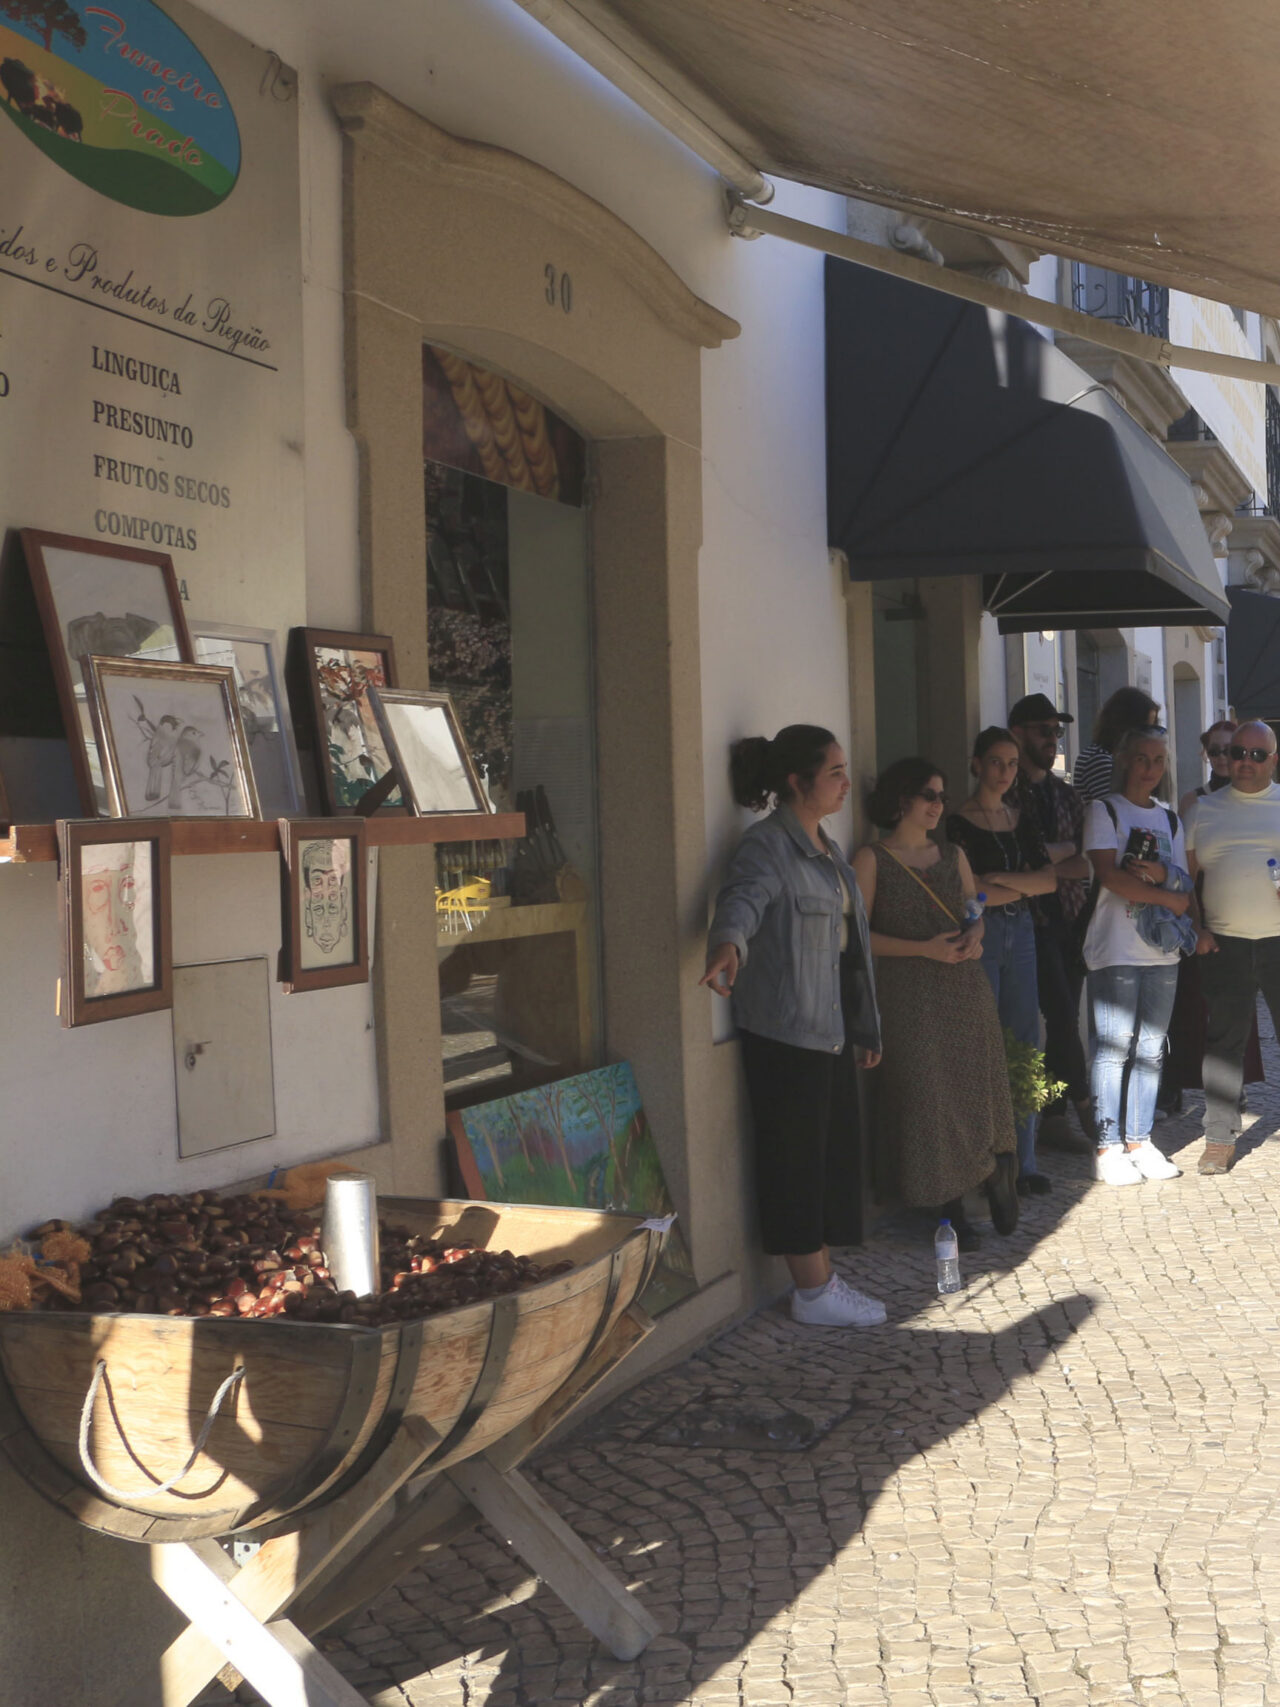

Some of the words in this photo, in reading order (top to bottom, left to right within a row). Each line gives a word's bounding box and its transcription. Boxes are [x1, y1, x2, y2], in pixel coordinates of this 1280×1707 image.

[85, 6, 223, 109] Fumeiro
[142, 86, 175, 112] do
[101, 88, 203, 166] Prado
[45, 255, 58, 273] e
[63, 243, 169, 316] Produtos
[173, 293, 199, 327] da
[202, 297, 272, 354] Região
[544, 262, 573, 315] 30
[91, 345, 183, 398] LINGUIÇA
[92, 400, 194, 449] PRESUNTO
[93, 454, 169, 495] FRUTOS
[174, 475, 231, 510] SECOS
[94, 508, 198, 551] COMPOTAS
